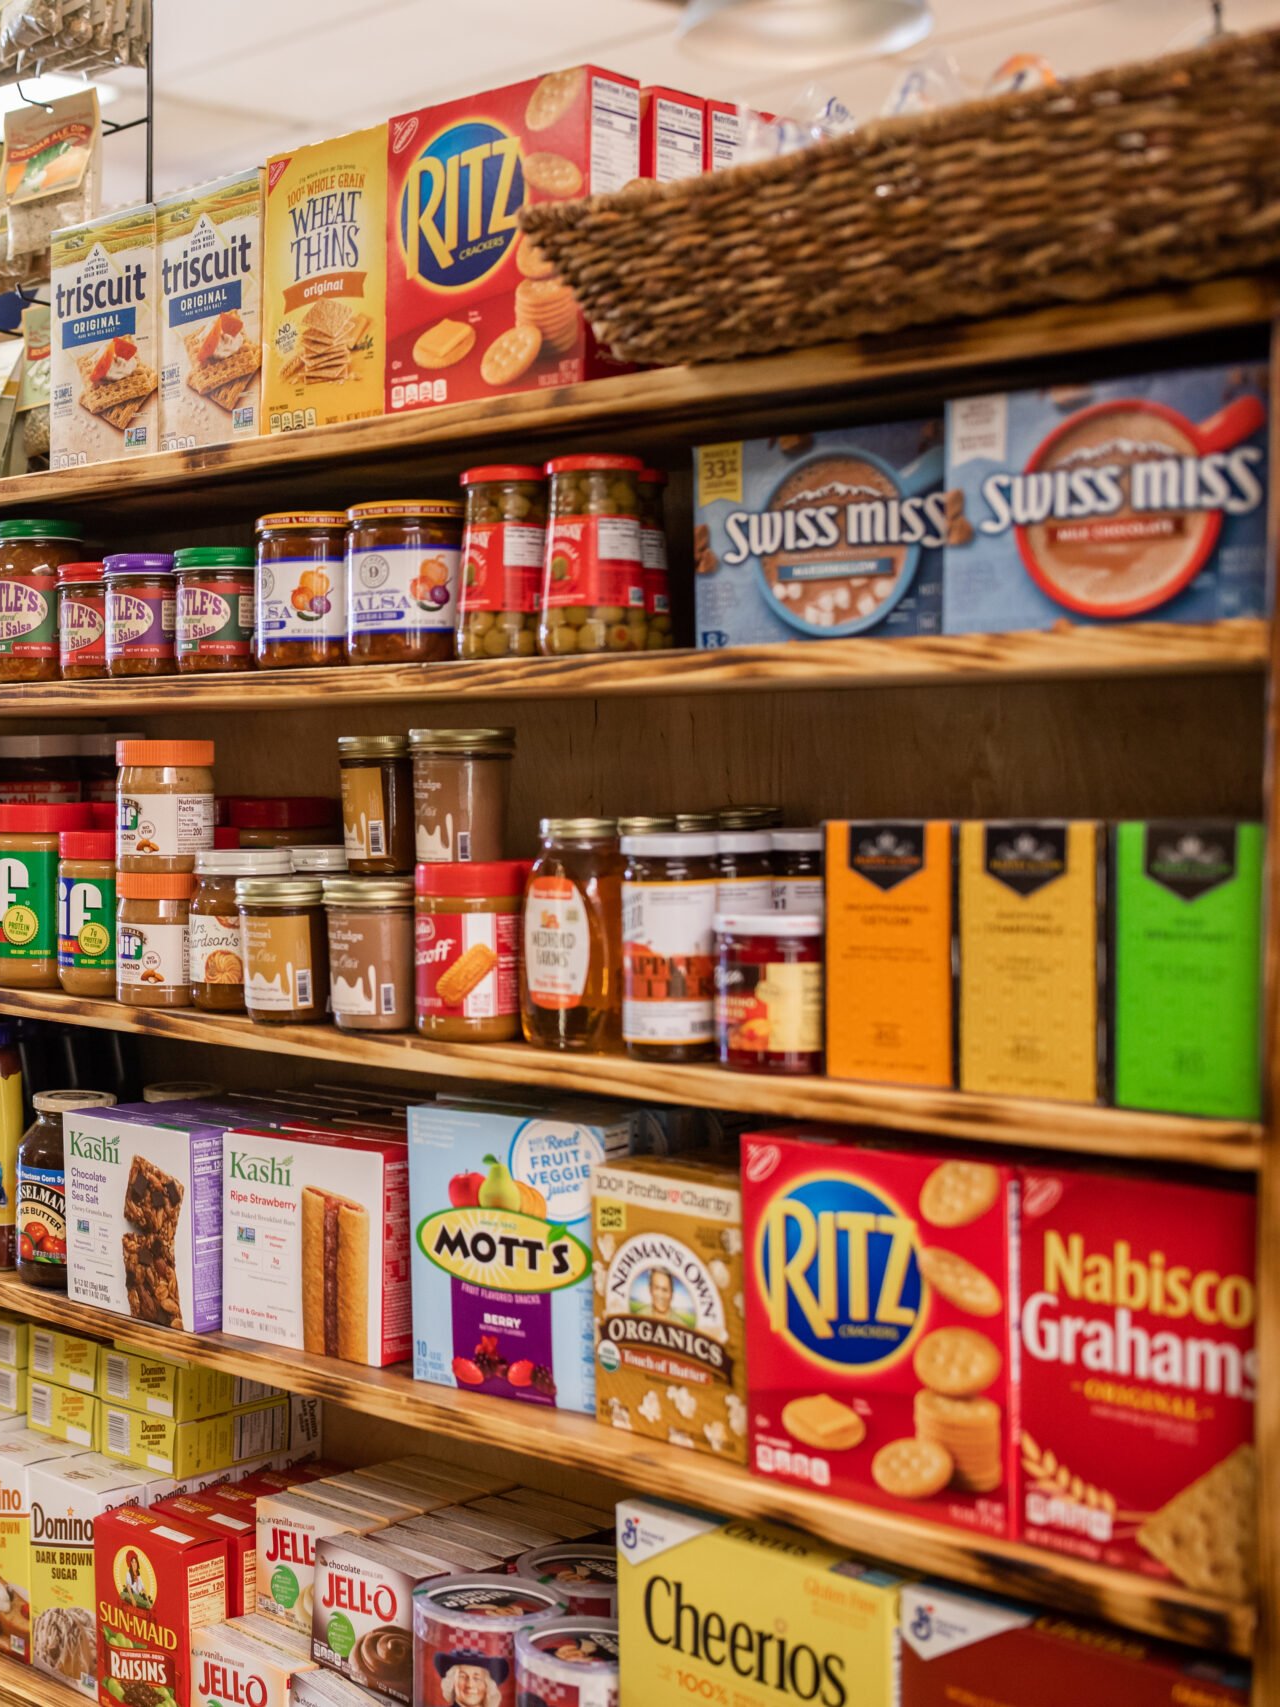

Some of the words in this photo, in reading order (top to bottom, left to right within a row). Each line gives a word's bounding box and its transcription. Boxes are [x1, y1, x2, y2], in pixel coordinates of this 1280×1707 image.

[52, 126, 69, 142] ALE
[70, 123, 87, 137] DIP
[307, 174, 335, 197] WHOLE
[337, 172, 366, 189] GRAIN
[288, 190, 362, 238] WHEAT
[406, 136, 521, 281] RITZ
[459, 236, 505, 261] CRACKERS
[161, 234, 252, 296] triscuit
[56, 264, 147, 319] triscuit
[303, 278, 344, 299] original
[180, 288, 228, 312] ORIGINAL
[73, 313, 121, 335] ORIGINAL
[278, 323, 291, 337] NO
[980, 465, 1124, 534] SWISS
[1131, 446, 1263, 514] MISS
[388, 506, 404, 514] WITH
[299, 516, 318, 524] MADE
[723, 506, 839, 565] SWISS
[846, 493, 948, 548] MISS
[5, 622, 32, 636] Salsa
[118, 628, 140, 643] Salsa
[192, 624, 216, 638] Salsa
[70, 636, 91, 648] Salsa
[178, 798, 203, 806] Nutrition
[178, 805, 195, 813] Facts
[140, 828, 153, 836] STIR
[192, 827, 203, 837] 200
[8, 920, 30, 932] PROTEIN
[15, 912, 24, 923] 7g
[83, 935, 103, 946] PROTEIN
[90, 928, 98, 937] 7g
[145, 959, 158, 967] STIR
[69, 1130, 120, 1165] Kashi
[545, 1130, 580, 1150] Real
[193, 1164, 212, 1172] Calories
[230, 1151, 291, 1187] Kashi
[530, 1150, 580, 1169] FRUIT
[41, 1174, 57, 1183] Corn
[71, 1167, 107, 1183] Chocolate
[527, 1164, 591, 1186] VEGGIE
[71, 1179, 99, 1194] Almond
[546, 1182, 580, 1201] juice
[71, 1191, 84, 1202] Sea
[85, 1194, 99, 1205] Salt
[230, 1190, 248, 1203] Ripe
[250, 1193, 297, 1212] Strawberry
[627, 1179, 668, 1202] Profits
[680, 1190, 733, 1217] Charity
[30, 1207, 62, 1231] BUTTER
[768, 1197, 918, 1339] RITZ
[611, 1240, 684, 1297] NEWMAN'S
[683, 1262, 716, 1319] OWN
[1043, 1229, 1254, 1330] Nabisco
[460, 1281, 480, 1297] FRUIT
[481, 1286, 512, 1303] FLAVORED
[514, 1293, 541, 1305] SNACKS
[232, 1305, 245, 1314] Fruit
[483, 1312, 522, 1329] BERRY
[416, 1339, 428, 1358] 10
[608, 1318, 723, 1367] ORGANICS
[1021, 1292, 1259, 1401] Grahams
[140, 1363, 166, 1377] Domino
[621, 1349, 651, 1369] Touch
[653, 1357, 667, 1374] of
[668, 1361, 708, 1383] Butter
[1084, 1378, 1201, 1421] ORIGINAL
[141, 1420, 166, 1434] Domino
[31, 1501, 95, 1542] Domino
[272, 1517, 293, 1528] vanilla
[36, 1550, 57, 1564] DARK
[59, 1552, 93, 1567] BROWN
[188, 1563, 210, 1574] Nutrition
[210, 1558, 225, 1568] Facts
[328, 1560, 361, 1575] chocolate
[51, 1568, 78, 1581] SUGAR
[189, 1589, 209, 1598] Calories
[212, 1580, 225, 1591] 120
[322, 1572, 398, 1623] JELL-O
[643, 1575, 848, 1707] Cheerios
[203, 1650, 224, 1663] vanilla
[110, 1651, 167, 1685] RAISINS
[198, 1660, 268, 1707] JELL-O
[676, 1669, 729, 1706] 100%
